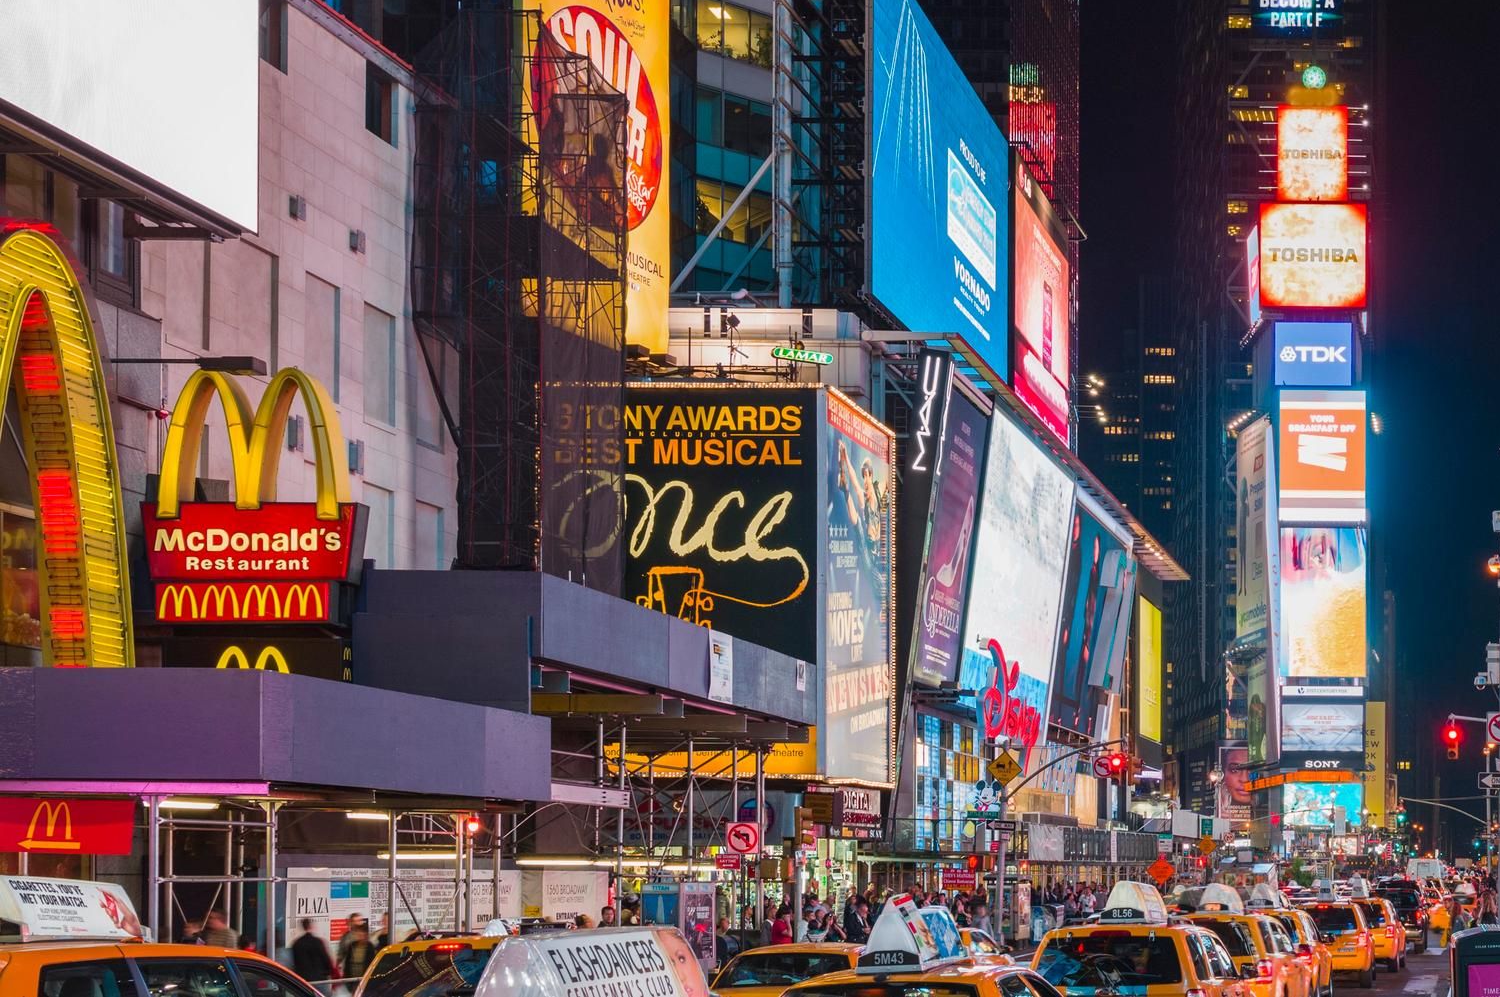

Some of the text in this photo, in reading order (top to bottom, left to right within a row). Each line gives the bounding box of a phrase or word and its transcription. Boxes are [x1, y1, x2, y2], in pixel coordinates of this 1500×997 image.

[1270, 12, 1303, 28] PART
[1283, 148, 1344, 160] TOSHIBA
[1268, 247, 1358, 263] TOSHIBA
[954, 255, 991, 312] VORNADO
[779, 347, 829, 364] LAMAR
[1294, 345, 1347, 363] TDK
[666, 404, 802, 431] AWARDS
[653, 438, 803, 466] MUSICAL
[154, 527, 342, 553] McDonald's
[185, 556, 310, 572] Restaurant
[828, 609, 865, 647] MOVES
[827, 663, 890, 715] NEWSIES
[773, 748, 804, 757] theatre
[1304, 760, 1341, 768] SONY
[8, 879, 59, 895] CIGARETTES,
[19, 893, 88, 908] MET YOUR MATCH.
[298, 896, 329, 915] PLAZA
[1111, 908, 1133, 919] 8L56
[547, 939, 666, 985] FLASHDANCERS
[874, 952, 904, 965] 5M43
[645, 974, 674, 997] CLUB
